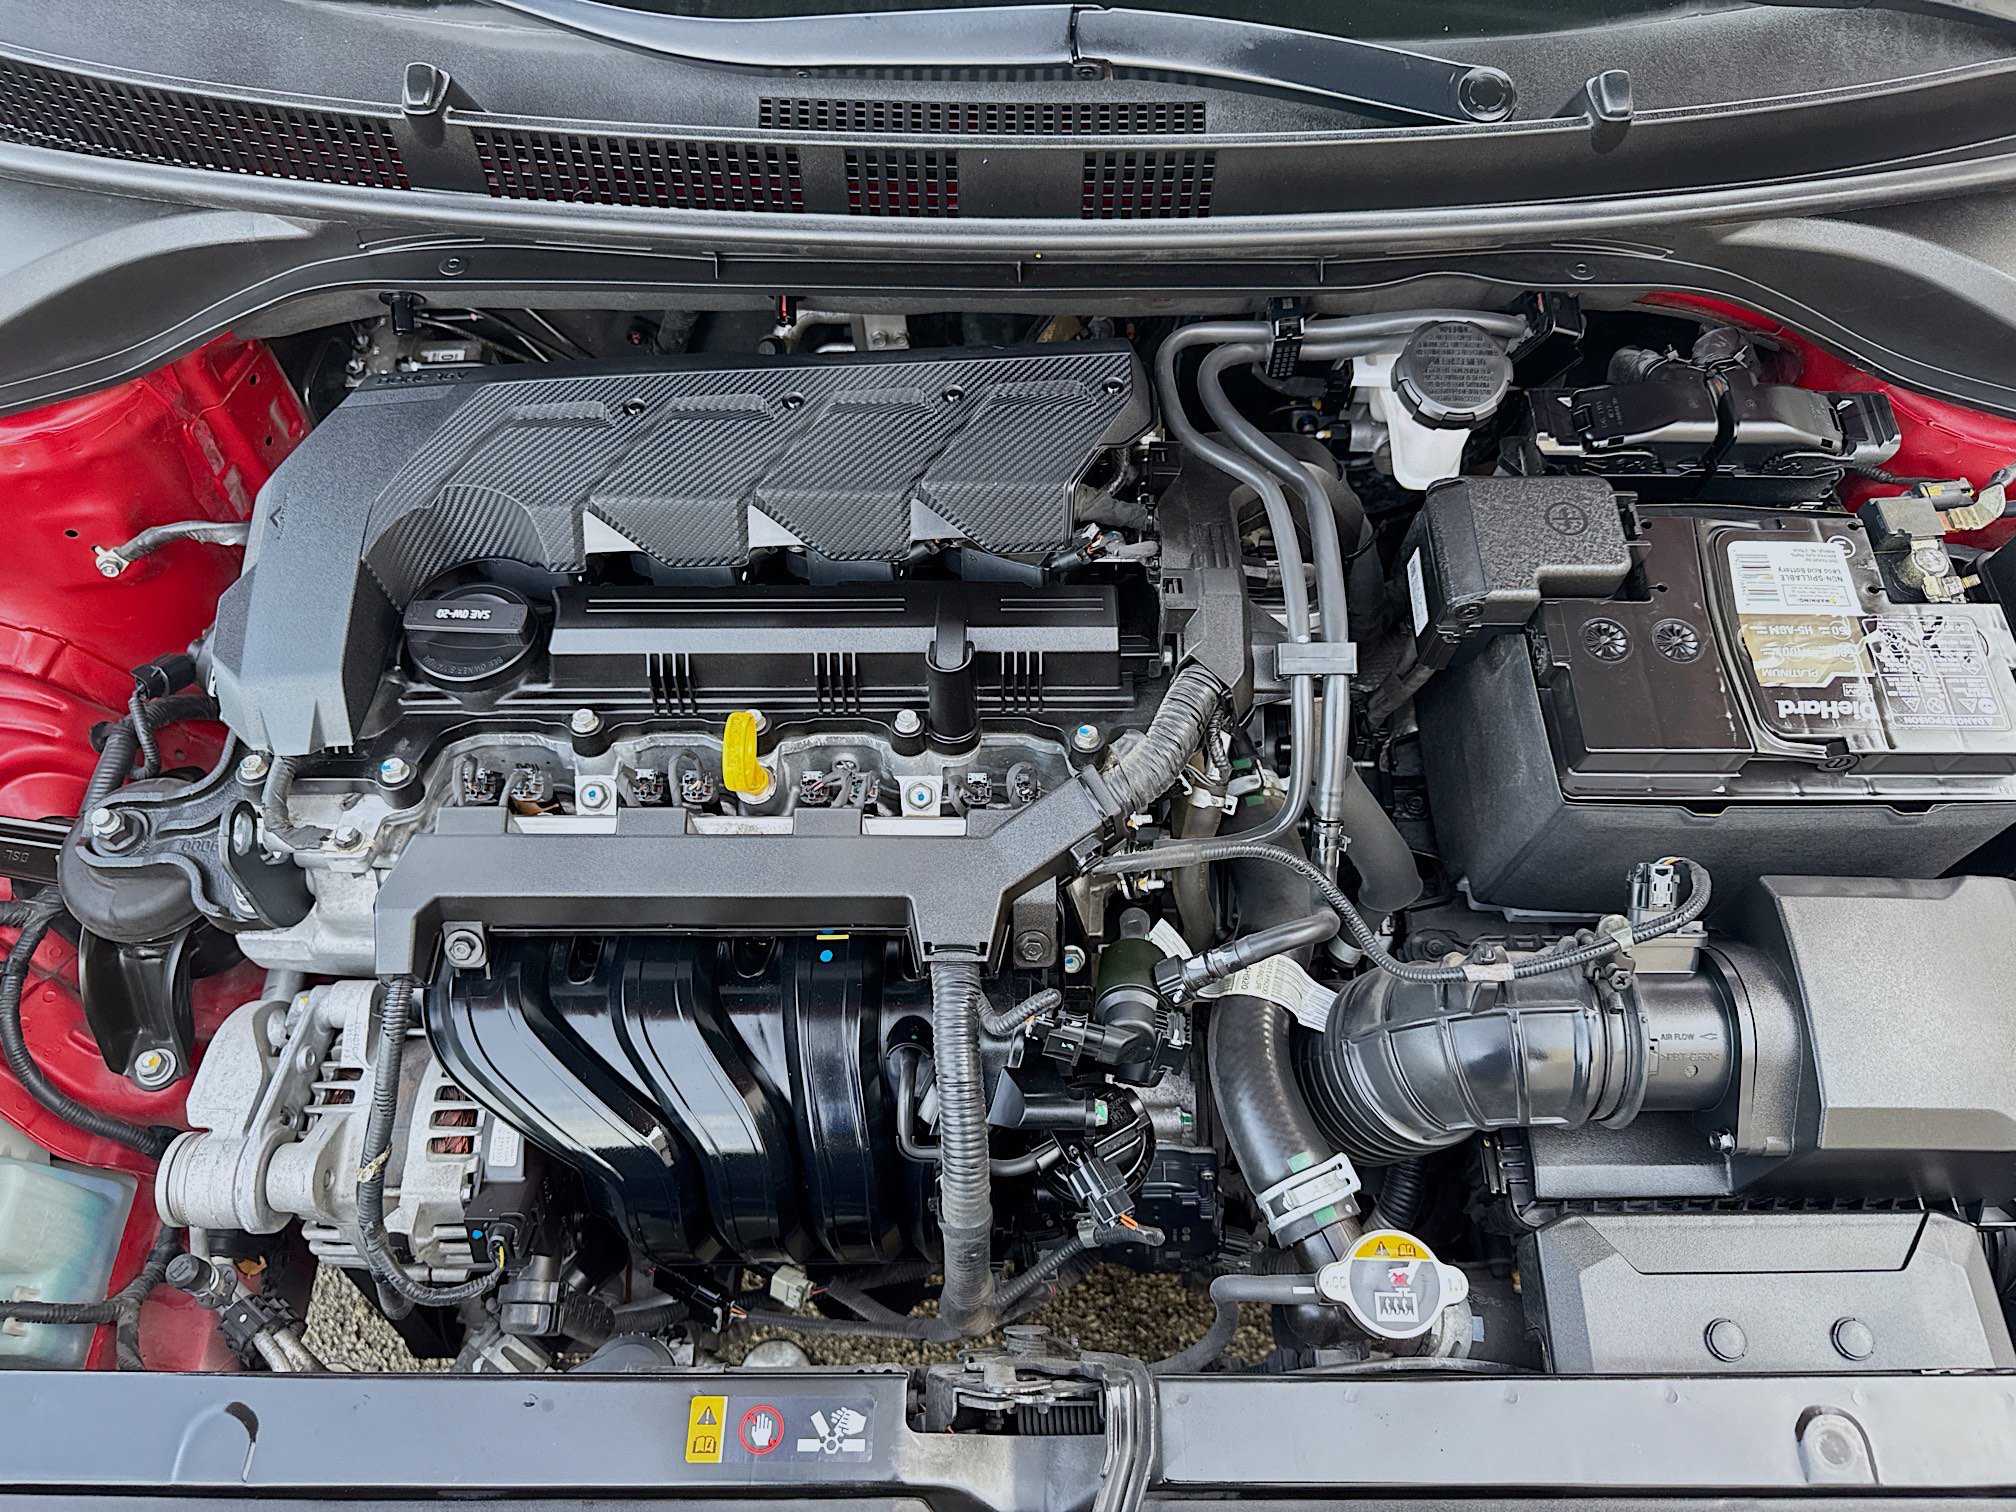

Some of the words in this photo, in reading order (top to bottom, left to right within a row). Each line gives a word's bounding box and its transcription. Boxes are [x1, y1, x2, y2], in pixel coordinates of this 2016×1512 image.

[1779, 574, 1844, 582] NON-SPILLABLE
[435, 608, 469, 619] 0W-20
[469, 609, 492, 620] SAE
[1768, 626, 1813, 636] H5-AGM
[1761, 668, 1819, 678] PLATINUM
[1777, 700, 1877, 719] DieHard
[1660, 1033, 1673, 1041] AIR
[1673, 1033, 1695, 1041] FLOW
